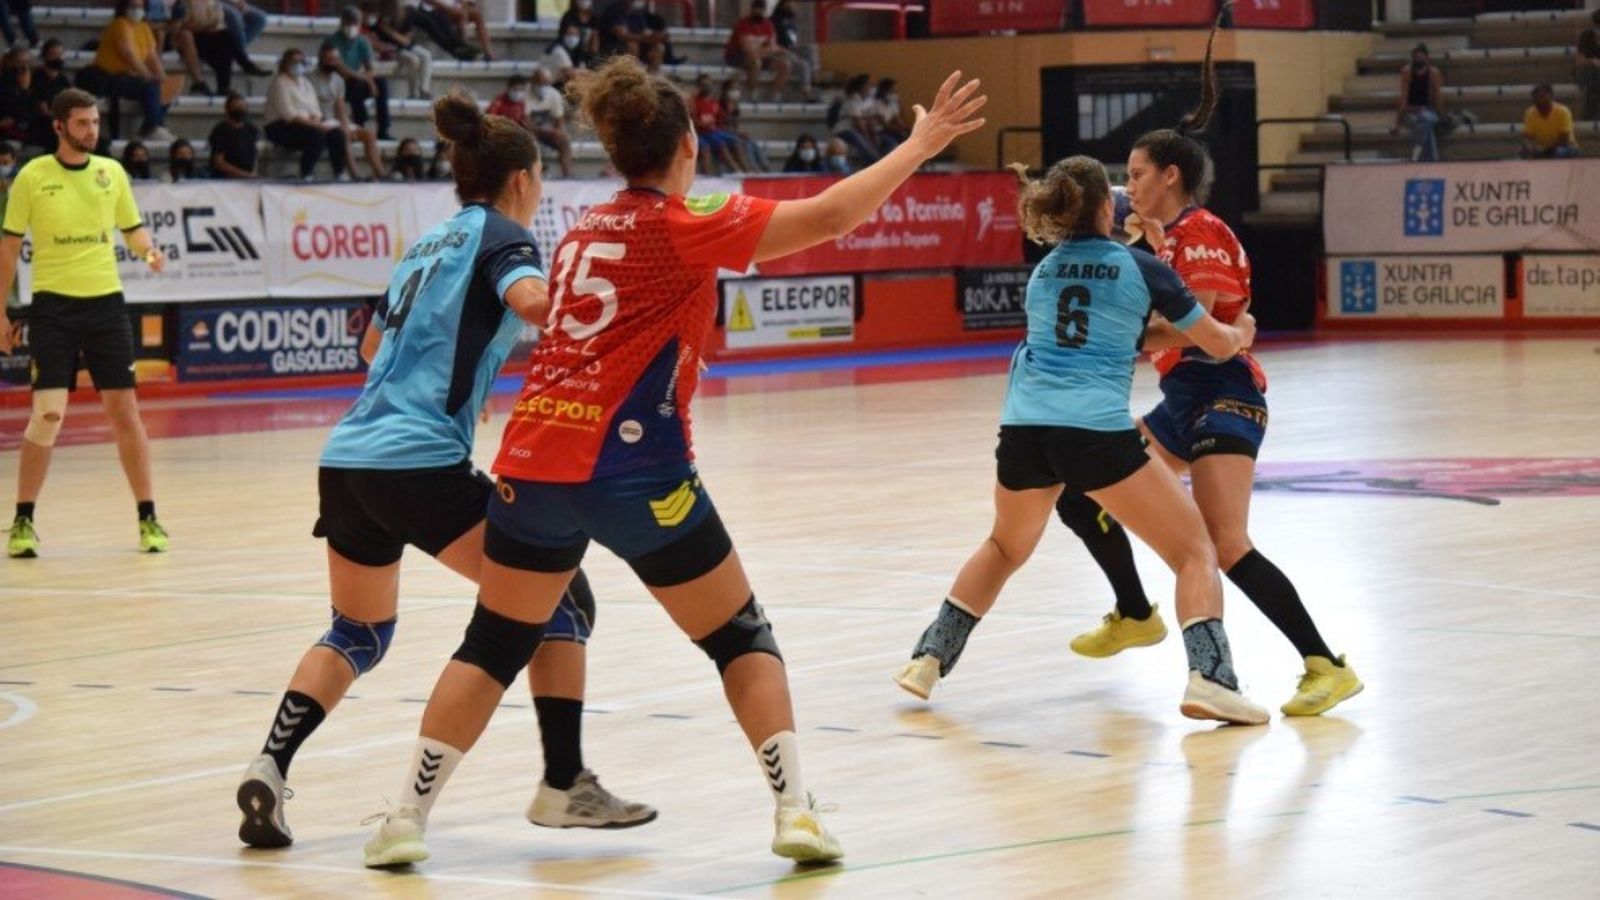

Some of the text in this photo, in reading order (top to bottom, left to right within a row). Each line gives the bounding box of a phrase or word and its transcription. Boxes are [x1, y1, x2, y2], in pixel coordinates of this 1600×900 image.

[1454, 180, 1531, 201] XUNTA
[1452, 204, 1579, 226] DE GALICIA
[1055, 263, 1121, 281] ZARCO
[1383, 263, 1452, 282] XUNTA
[544, 240, 627, 341] 15
[762, 285, 851, 312] ELECPOR
[1383, 284, 1497, 305] DE GALICIA
[1055, 285, 1091, 349] 6
[215, 308, 358, 353] CODISOIL
